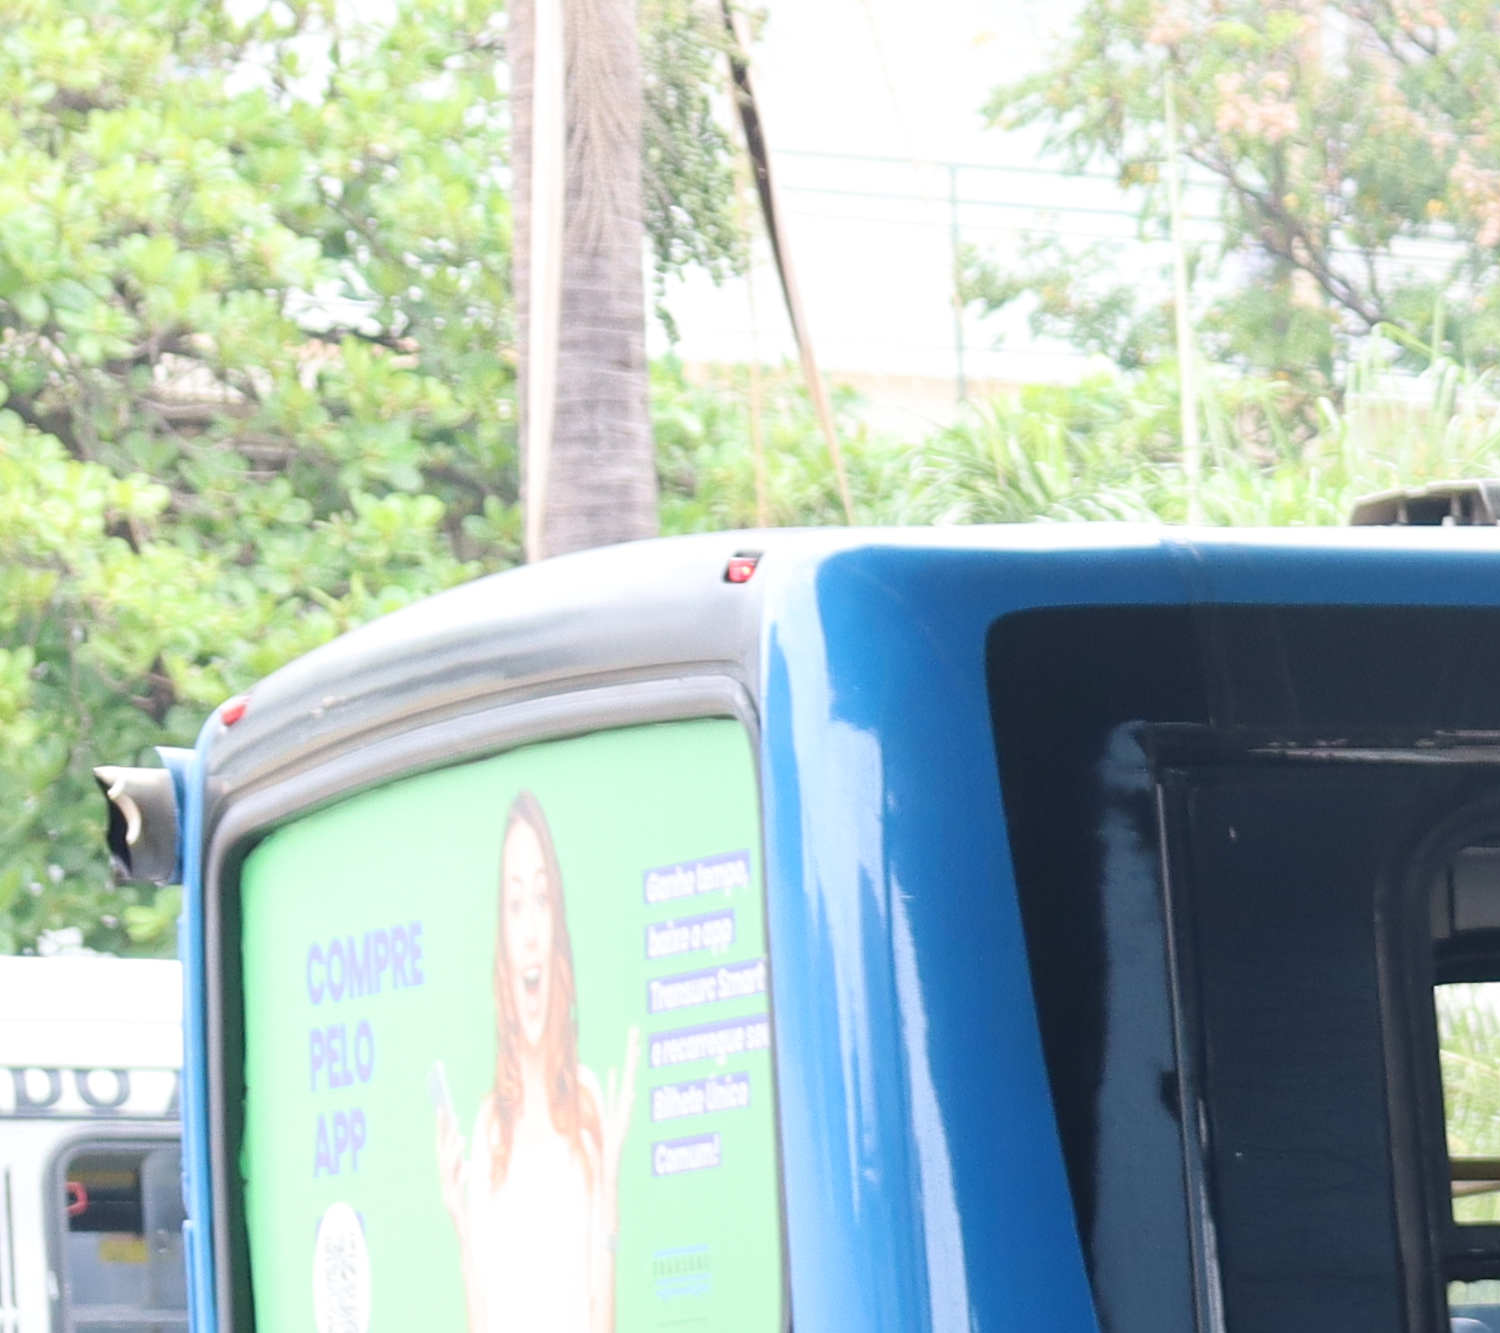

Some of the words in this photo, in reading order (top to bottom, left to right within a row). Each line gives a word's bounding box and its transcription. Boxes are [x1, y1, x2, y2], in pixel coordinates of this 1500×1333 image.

[646, 864, 695, 902] Ganhe
[647, 919, 690, 958] baixe
[690, 923, 701, 949] o
[701, 917, 733, 955] app
[306, 920, 426, 1006] COMPRE
[717, 959, 766, 1000] Smart
[309, 1018, 375, 1092] PELO
[651, 1041, 662, 1067] e
[661, 1026, 745, 1067] recarregue
[651, 1084, 705, 1122] Bilhete
[705, 1072, 749, 1111] Único
[312, 1107, 367, 1178] APP
